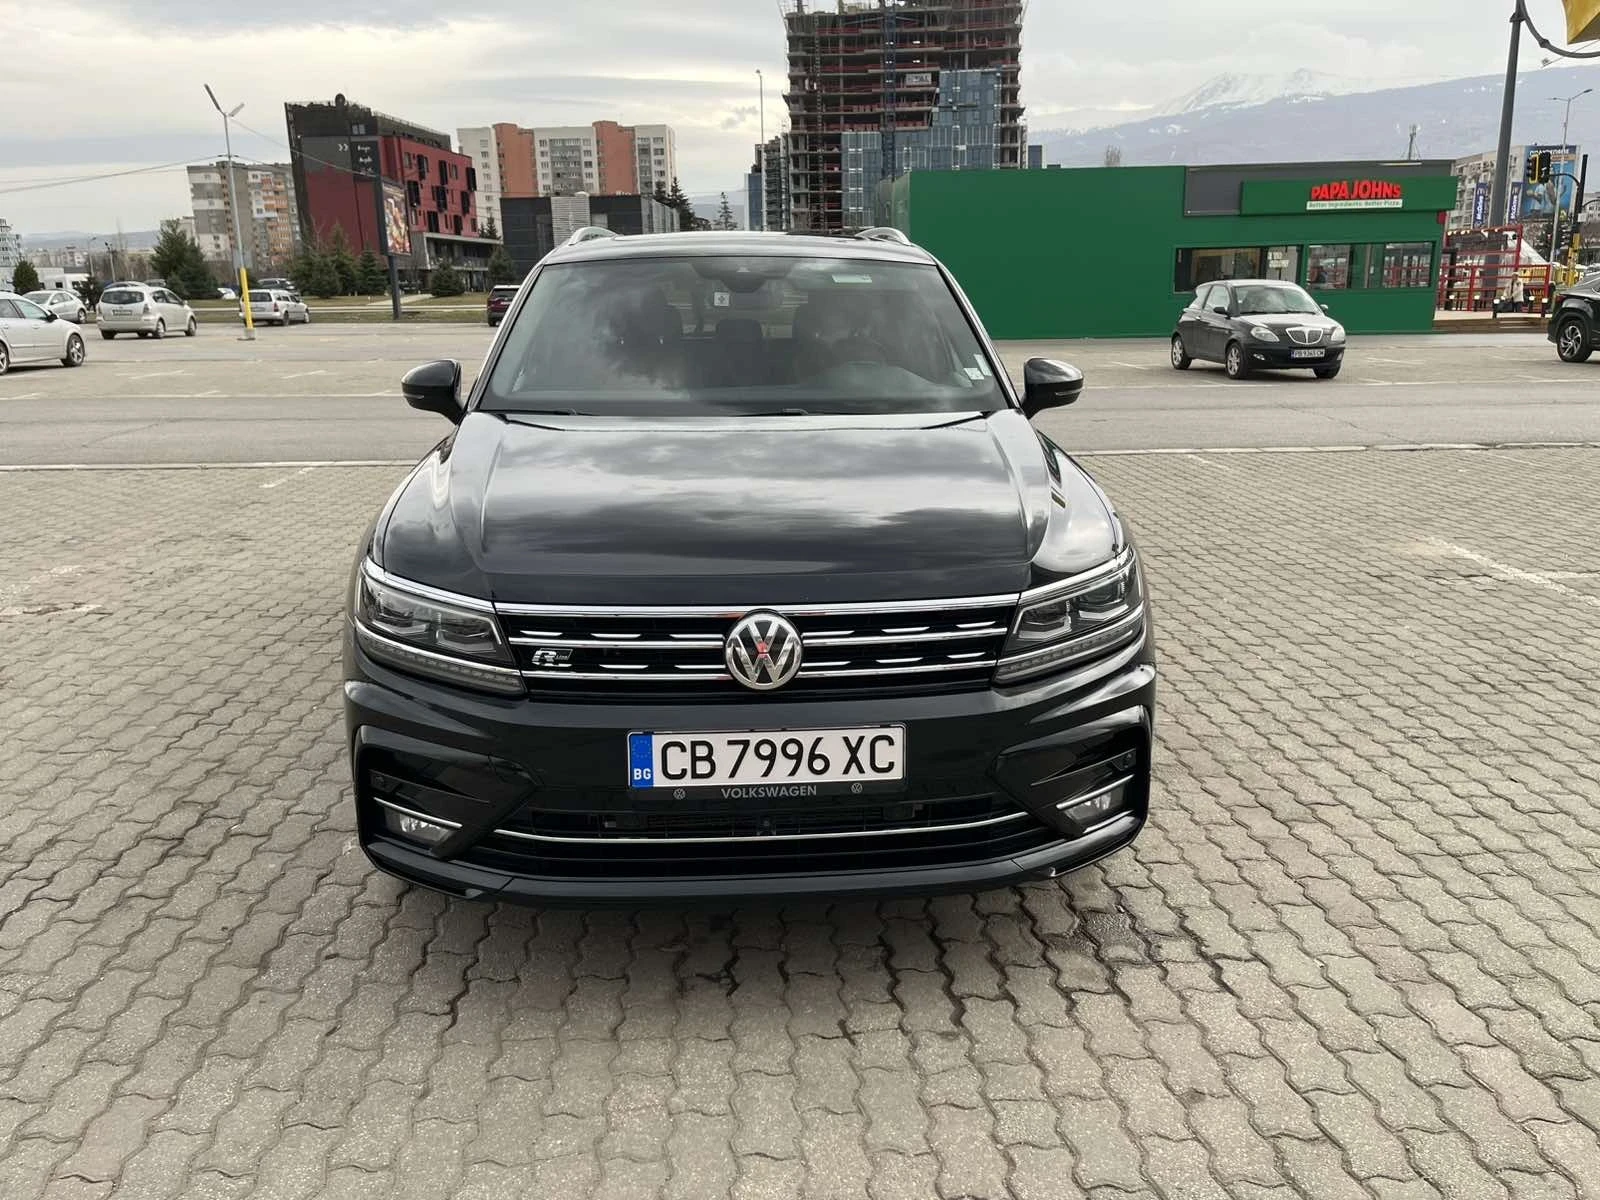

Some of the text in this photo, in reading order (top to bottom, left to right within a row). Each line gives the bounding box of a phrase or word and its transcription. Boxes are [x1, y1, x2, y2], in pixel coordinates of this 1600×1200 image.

[1311, 180, 1402, 200] PAPA JOHNS
[660, 734, 896, 781] CB 7996 XC
[633, 768, 652, 780] BG
[720, 785, 817, 799] VOLKSWAGEN
